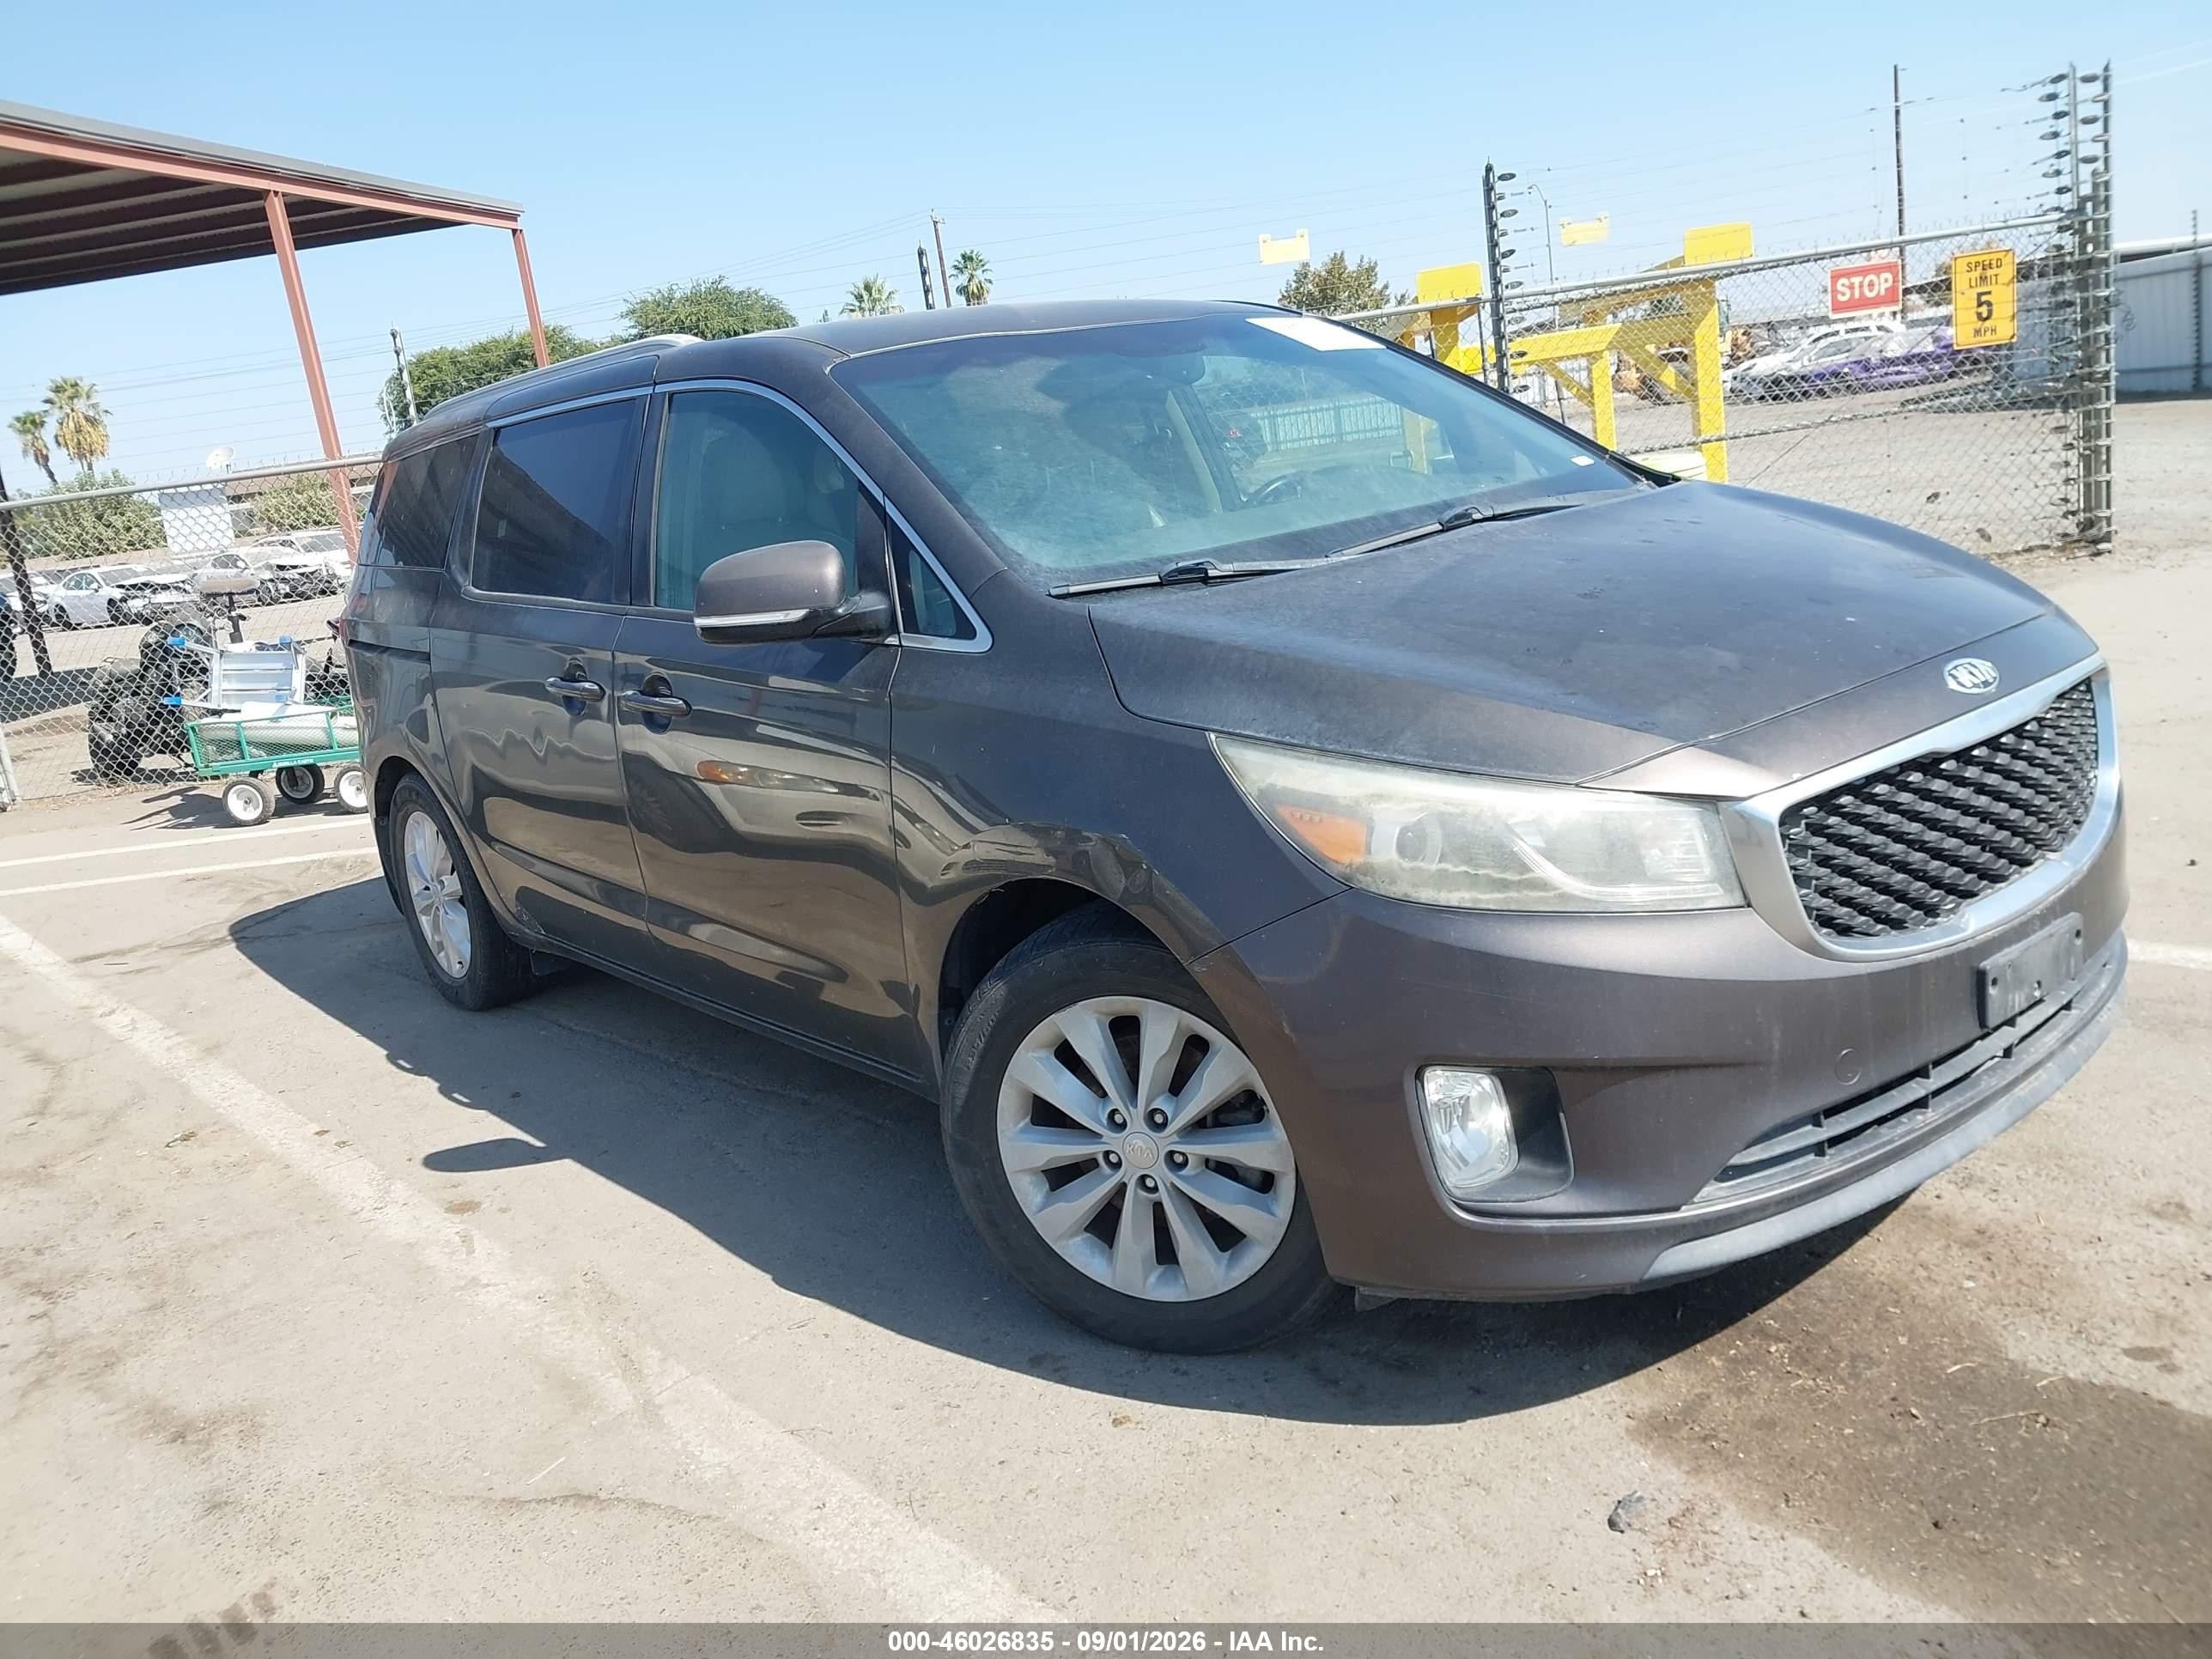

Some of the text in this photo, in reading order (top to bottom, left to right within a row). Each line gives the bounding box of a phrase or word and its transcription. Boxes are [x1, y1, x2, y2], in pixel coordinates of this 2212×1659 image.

[1966, 258, 2002, 273] SPEED
[1836, 271, 1893, 302] STOP
[1968, 273, 2000, 289] LIMIT
[1976, 290, 1993, 323] 5
[1972, 324, 1997, 338] MPH
[1126, 1141, 1155, 1160] KIA
